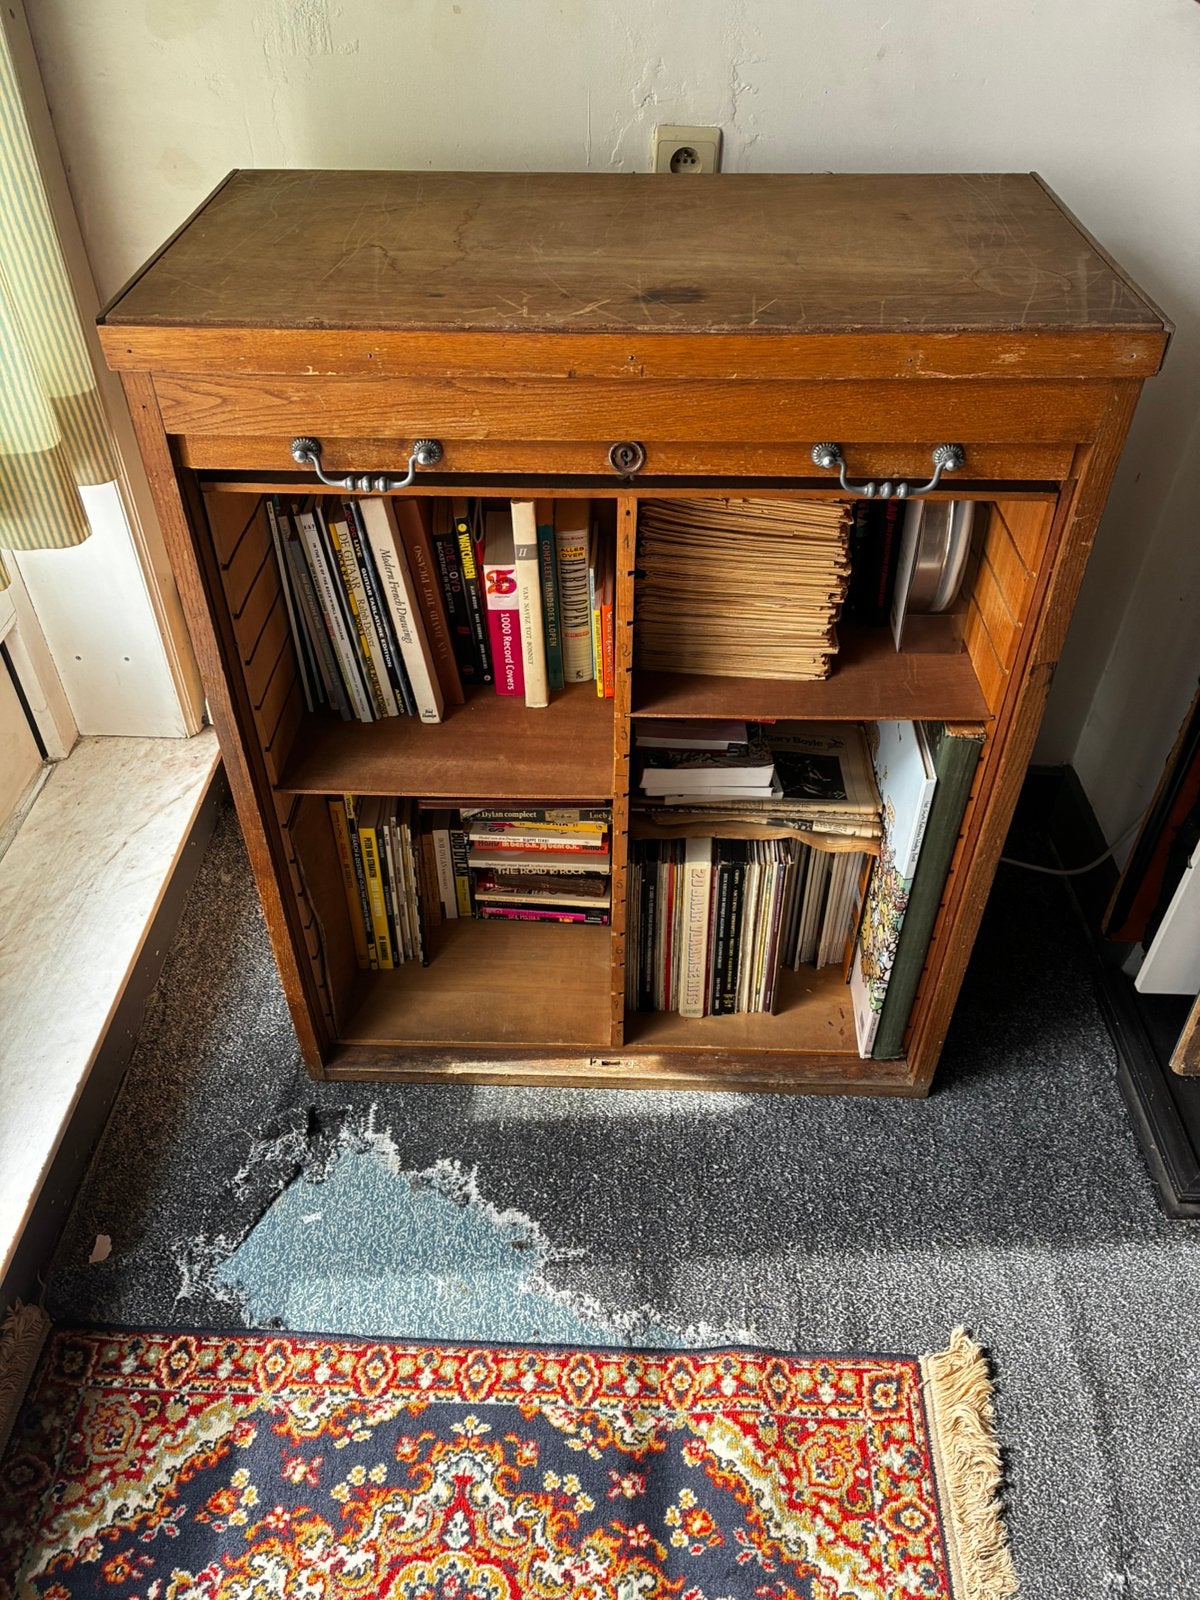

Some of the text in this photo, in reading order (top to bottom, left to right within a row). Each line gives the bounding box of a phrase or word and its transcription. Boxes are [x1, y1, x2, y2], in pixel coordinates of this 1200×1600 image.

[441, 539, 461, 593] JOE BOYD
[457, 533, 476, 579] WATCHMEN
[319, 568, 325, 576] OF
[435, 540, 448, 575] BACKSTAGE
[445, 591, 455, 614] SIXTIES
[337, 531, 376, 648] DE GITAAR Ralph Denver
[378, 546, 416, 646] Modern French Drawings
[411, 544, 448, 659] VAN DAVID TOT PICASSO
[540, 539, 558, 647] COMPLEET HANDBOEK LOPEN
[558, 557, 588, 629] HARDLOPEN
[343, 509, 404, 713] AC/DC LIVE GUITAR TABLATURE EDITION AMSCO
[499, 611, 512, 634] 1000
[335, 548, 345, 568] ROCK
[342, 577, 353, 596] ROLL
[370, 672, 388, 718] PUBLICATIONS
[521, 585, 535, 665] VAN NAVEZ TOT BONNET
[502, 634, 514, 664] Record
[504, 663, 517, 690] Covers
[619, 726, 629, 741] 3
[793, 736, 824, 748] Boyle
[480, 809, 537, 818] Dylan compleet
[616, 806, 625, 818] 4
[363, 835, 372, 848] PETER
[365, 849, 374, 858] VAN
[437, 837, 445, 848] BOB
[451, 831, 468, 876] BOB DYLAN
[350, 832, 358, 851] SEARCH
[354, 858, 363, 880] DESTROY
[366, 858, 377, 878] STRAATEN
[438, 849, 448, 868] DYLAN
[498, 866, 519, 875] THE
[520, 867, 547, 876] ROAD
[615, 878, 624, 889] 5
[690, 867, 706, 888] 20
[689, 888, 705, 922] JAAR
[615, 945, 623, 956] 6
[686, 925, 703, 978] VLAAMSE
[685, 978, 701, 1005] HITS
